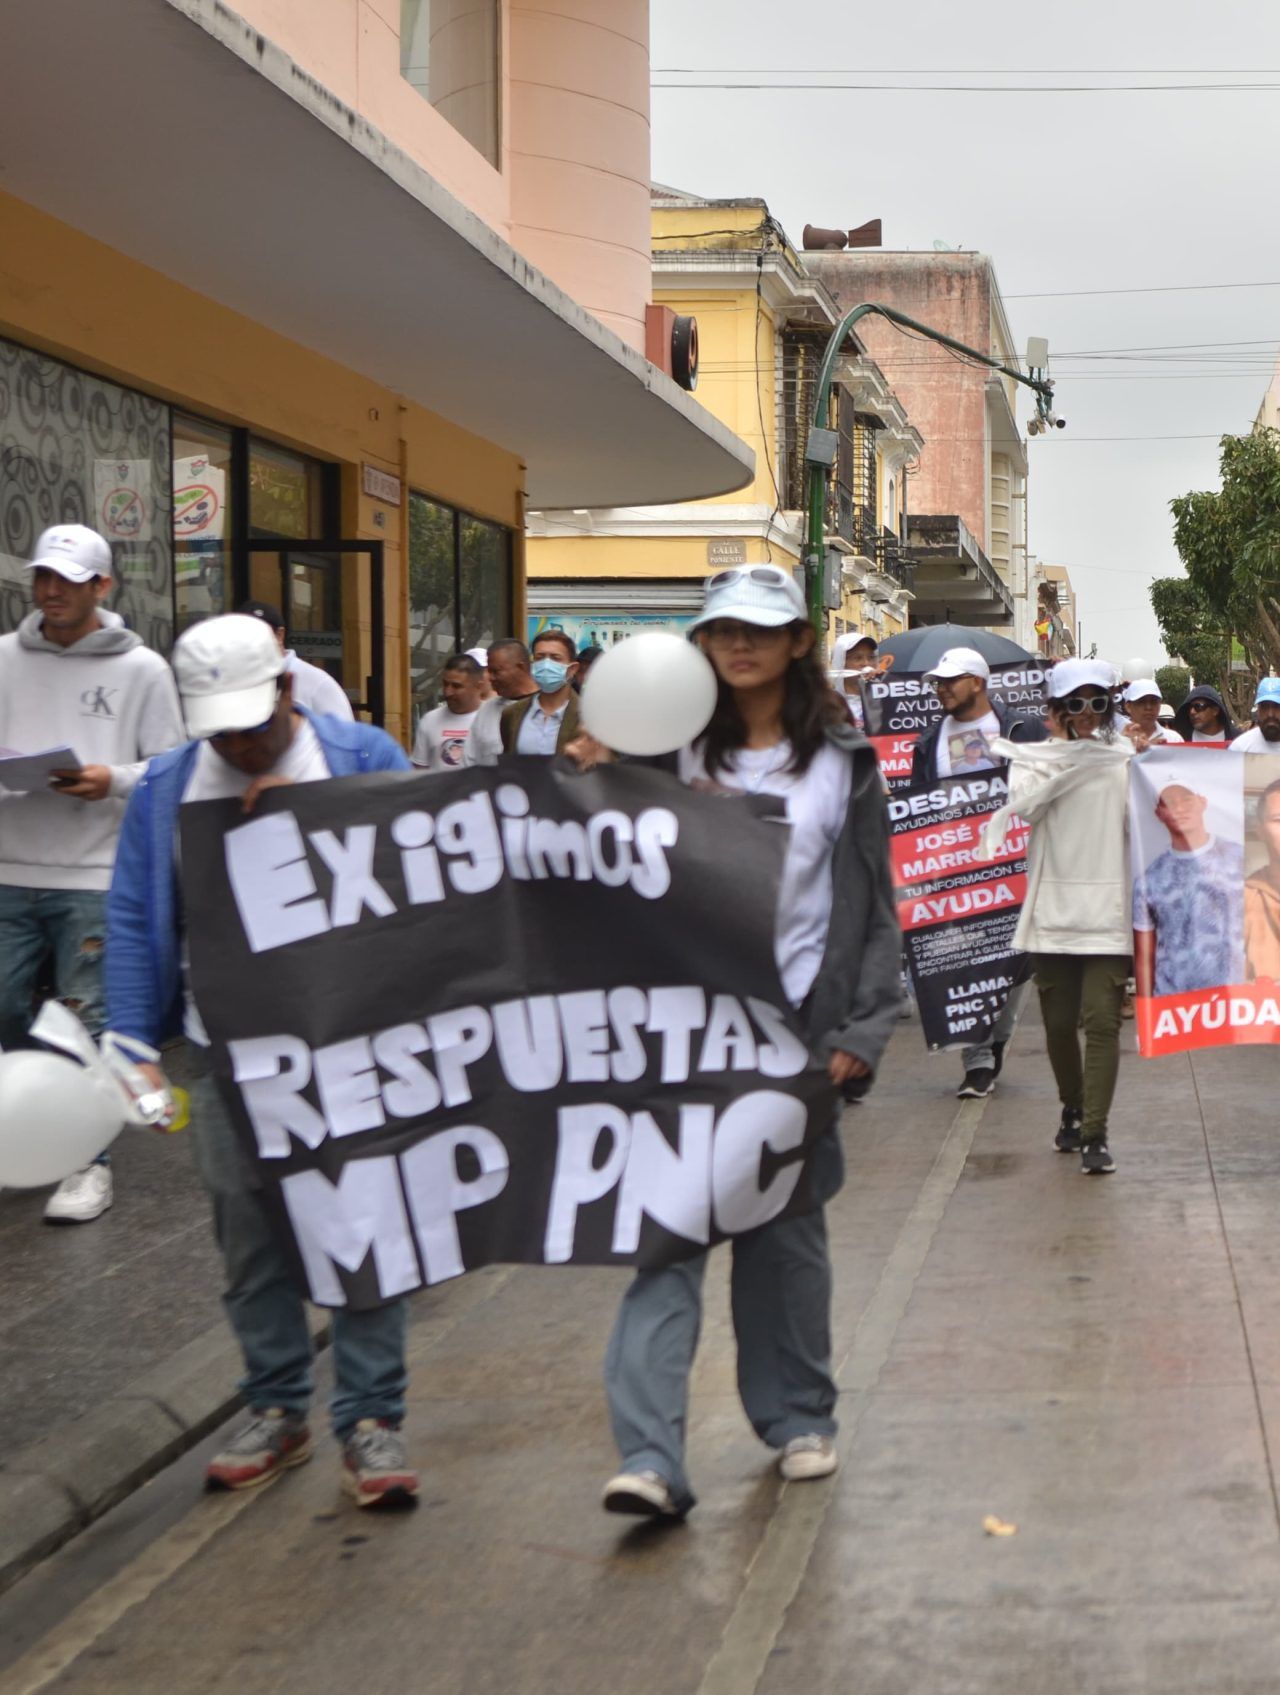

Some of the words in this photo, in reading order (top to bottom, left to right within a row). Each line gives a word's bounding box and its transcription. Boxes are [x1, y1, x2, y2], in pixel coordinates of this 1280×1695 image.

[713, 546, 740, 554] CALLE
[1007, 689, 1043, 703] DAR
[889, 716, 927, 730] CON
[888, 777, 1009, 822] DESAPA
[964, 806, 975, 815] A
[975, 800, 1003, 813] DAR
[915, 824, 974, 853] JOSÉ
[223, 783, 679, 954] Exigimos
[904, 885, 923, 898] TU
[925, 865, 1013, 894] INFORMACIÓN
[1015, 860, 1028, 871] SE
[911, 884, 1016, 924] AYUDA
[911, 927, 962, 945] CUALQUIER
[922, 936, 965, 951] DETALLES
[968, 931, 987, 941] QUE
[987, 923, 1017, 935] TENGA
[916, 953, 922, 961] Y
[923, 945, 961, 960] PUEDAN
[917, 950, 974, 969] ENCONTRAR
[974, 948, 982, 956] A
[918, 966, 939, 977] POR
[940, 961, 969, 972] FAVOR
[947, 975, 1014, 1000] LLAMA:
[945, 998, 985, 1017] PNC
[947, 1016, 978, 1034] MP
[228, 985, 810, 1159] RESPUESTAS
[280, 1123, 510, 1306] MP
[543, 1089, 809, 1264] PNC
